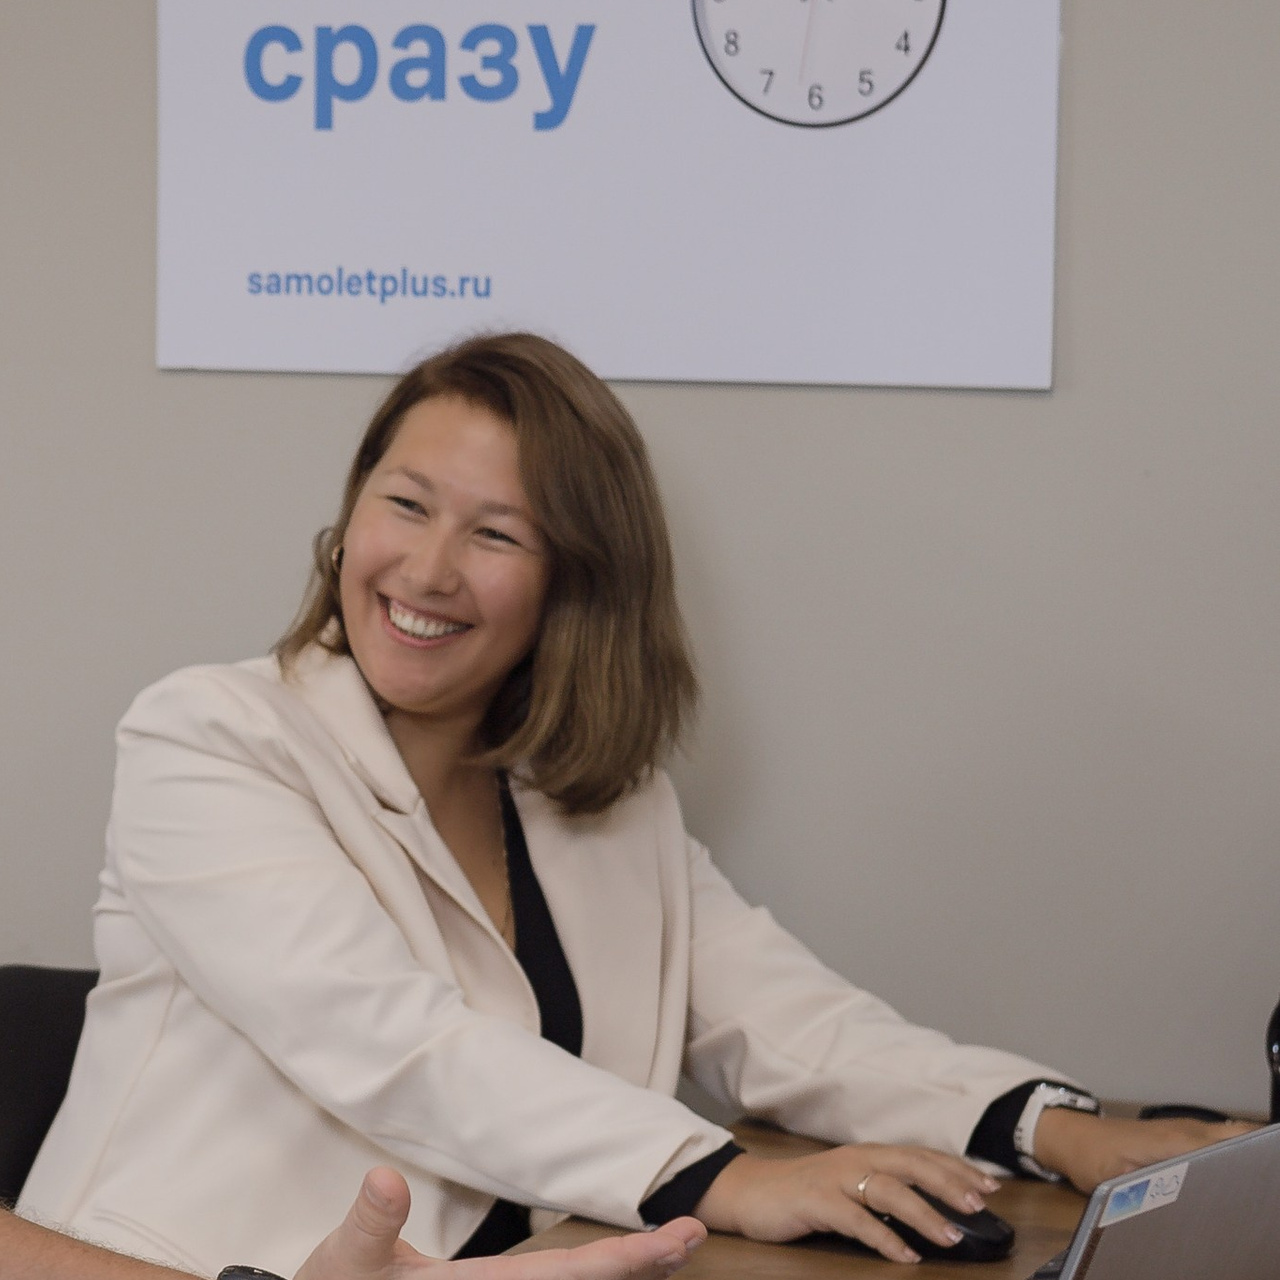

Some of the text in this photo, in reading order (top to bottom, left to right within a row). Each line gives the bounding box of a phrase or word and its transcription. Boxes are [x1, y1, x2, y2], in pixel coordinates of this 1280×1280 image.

[724, 30, 741, 58] 8
[894, 29, 911, 57] 4
[243, 23, 597, 132] сразу
[760, 69, 776, 95] 7
[858, 69, 876, 98] 5
[807, 84, 825, 111] 6
[248, 268, 492, 302] samoletplus.ru
